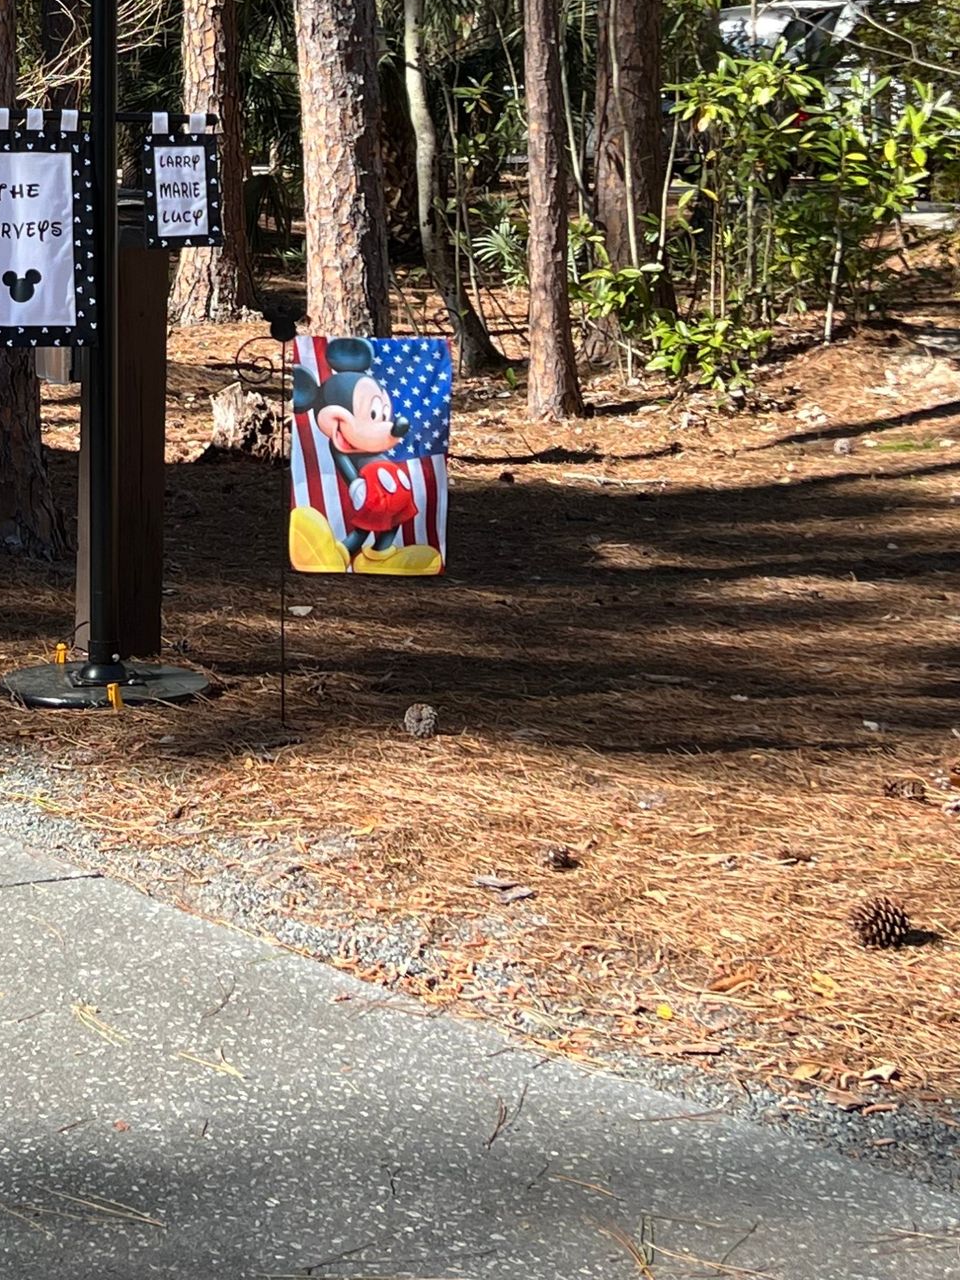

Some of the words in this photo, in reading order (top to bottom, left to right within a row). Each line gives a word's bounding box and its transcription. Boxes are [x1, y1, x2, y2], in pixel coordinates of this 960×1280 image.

[159, 154, 201, 171] LARRY
[159, 182, 200, 199] MARIE
[162, 209, 203, 226] LUCY
